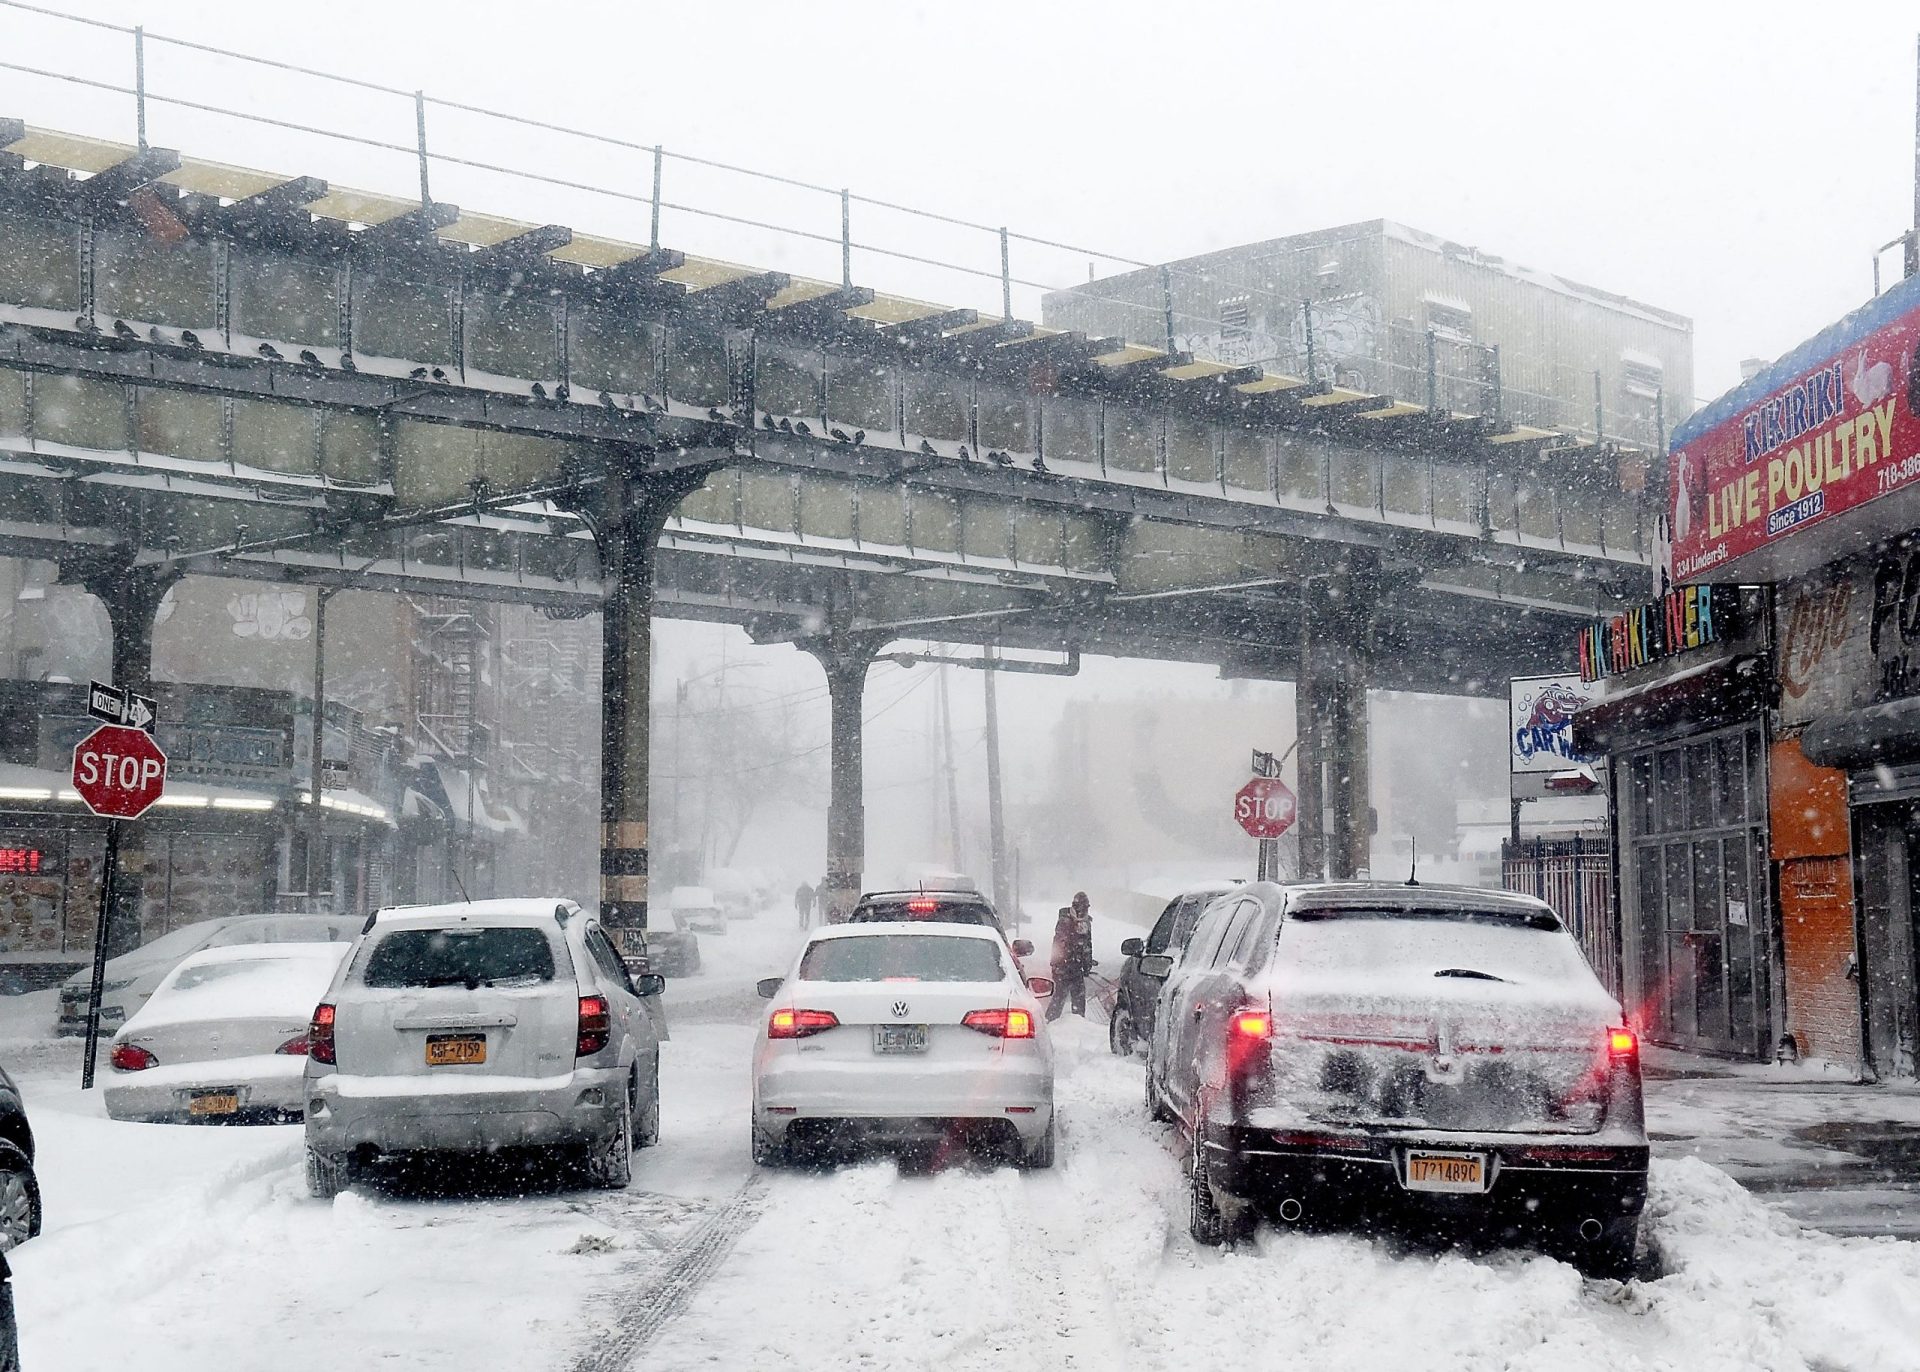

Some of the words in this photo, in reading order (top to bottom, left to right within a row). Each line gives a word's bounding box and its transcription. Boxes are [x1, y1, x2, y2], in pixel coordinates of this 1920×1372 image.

[1744, 360, 1844, 465] KIKIRIKI
[1709, 469, 1761, 540] LIVE
[1768, 398, 1896, 512] POULTRY
[1769, 509, 1795, 532] Since
[1797, 495, 1821, 520] 1912
[97, 695, 115, 713] ONE
[1517, 726, 1557, 758] CAR
[80, 751, 161, 791] STOP
[1239, 795, 1292, 819] STOP
